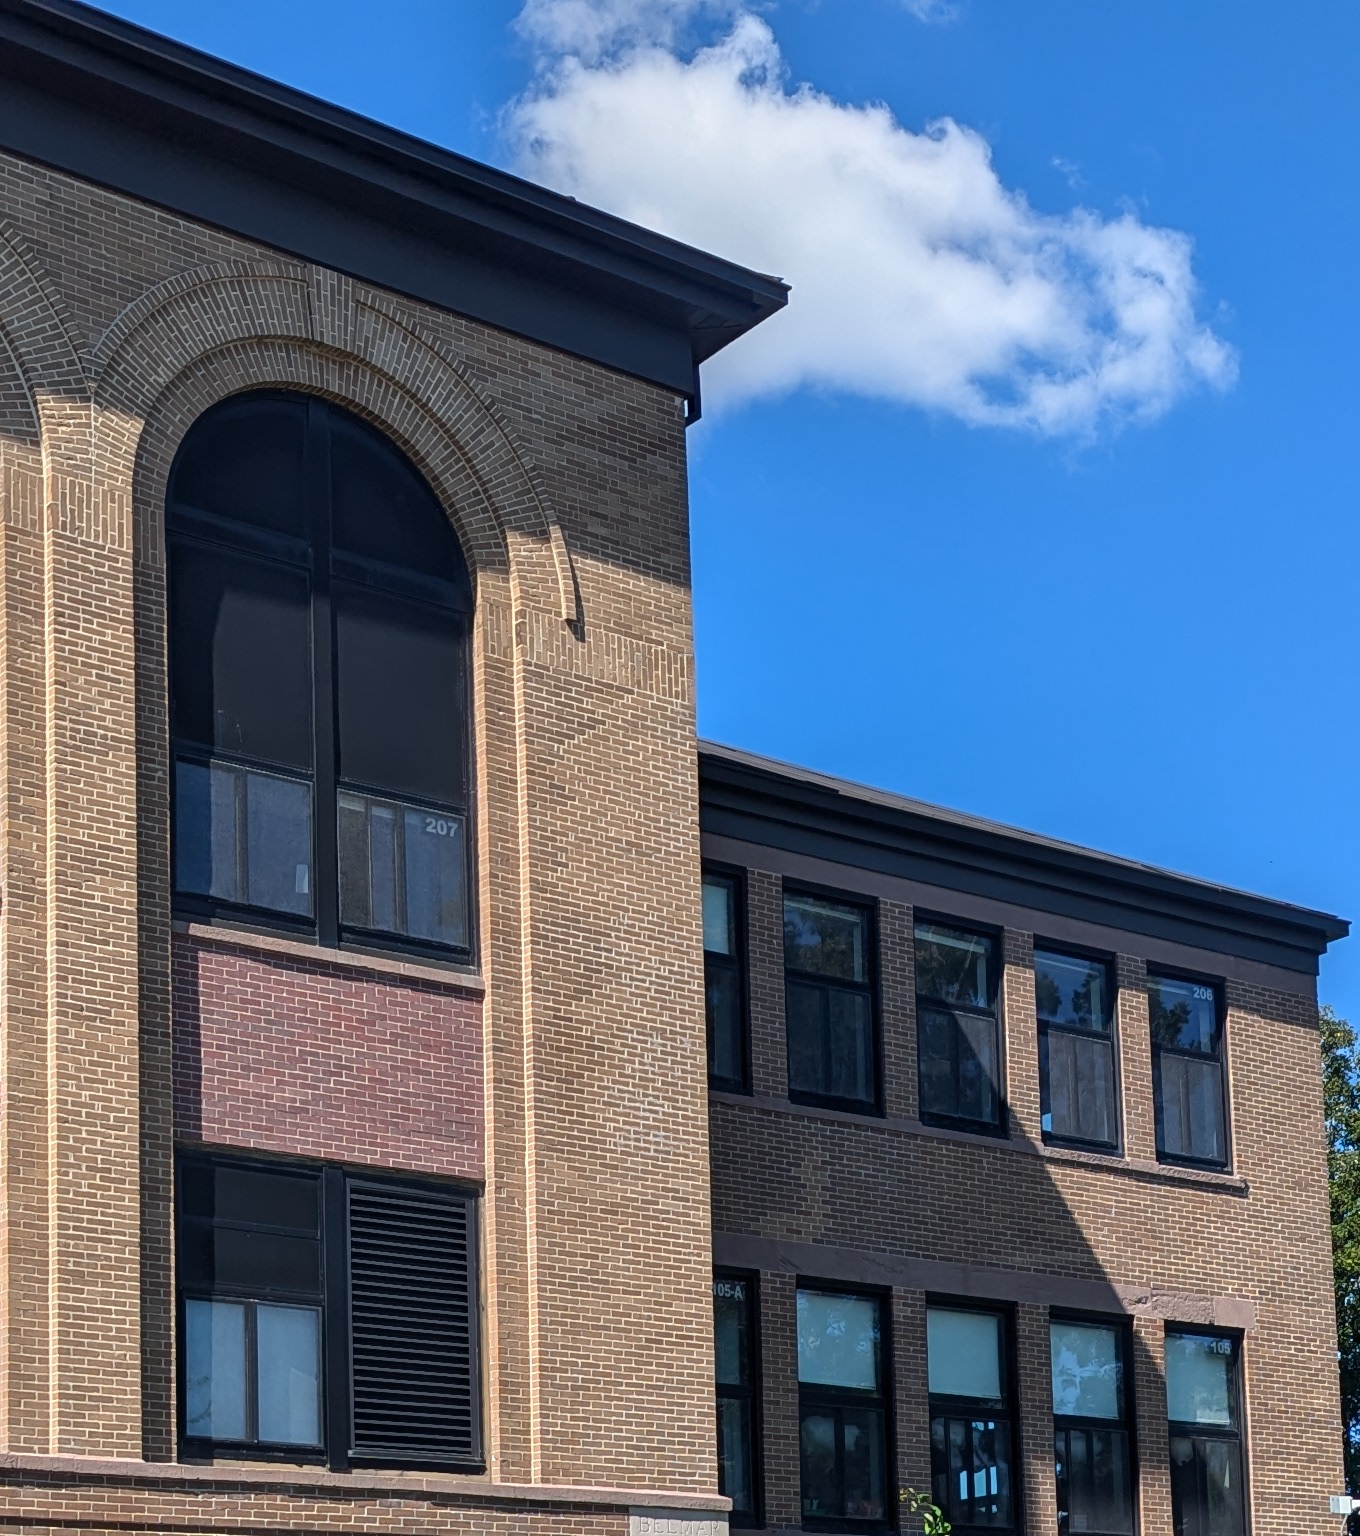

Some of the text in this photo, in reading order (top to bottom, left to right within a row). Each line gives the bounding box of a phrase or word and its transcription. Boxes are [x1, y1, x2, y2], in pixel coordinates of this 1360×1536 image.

[425, 817, 458, 838] 207
[1193, 986, 1213, 1001] 206
[713, 1282, 743, 1301] 105-A
[1210, 1341, 1231, 1355] 105
[638, 1516, 721, 1536] BELMAR
